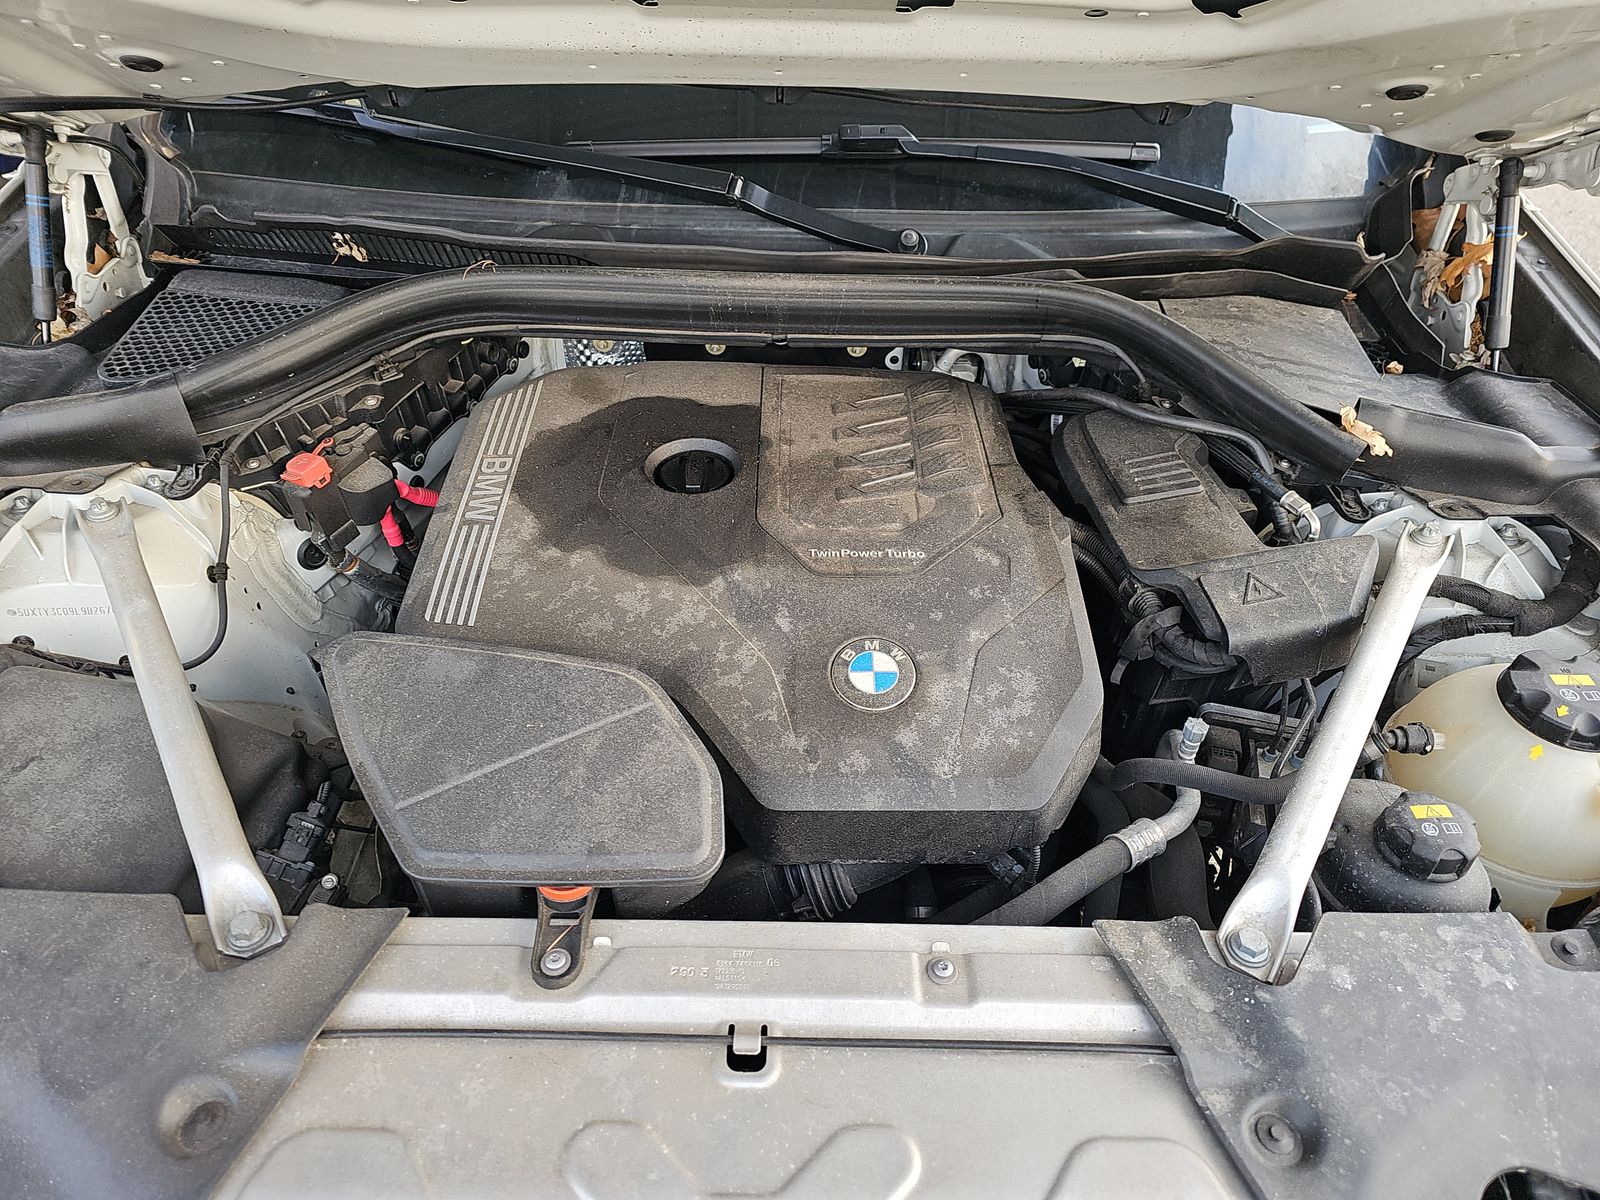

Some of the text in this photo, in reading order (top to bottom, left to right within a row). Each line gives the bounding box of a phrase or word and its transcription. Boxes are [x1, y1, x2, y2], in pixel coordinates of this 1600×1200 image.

[465, 457, 512, 521] BMW
[809, 548, 926, 558] TwinPower Turbo
[840, 640, 906, 662] BMW
